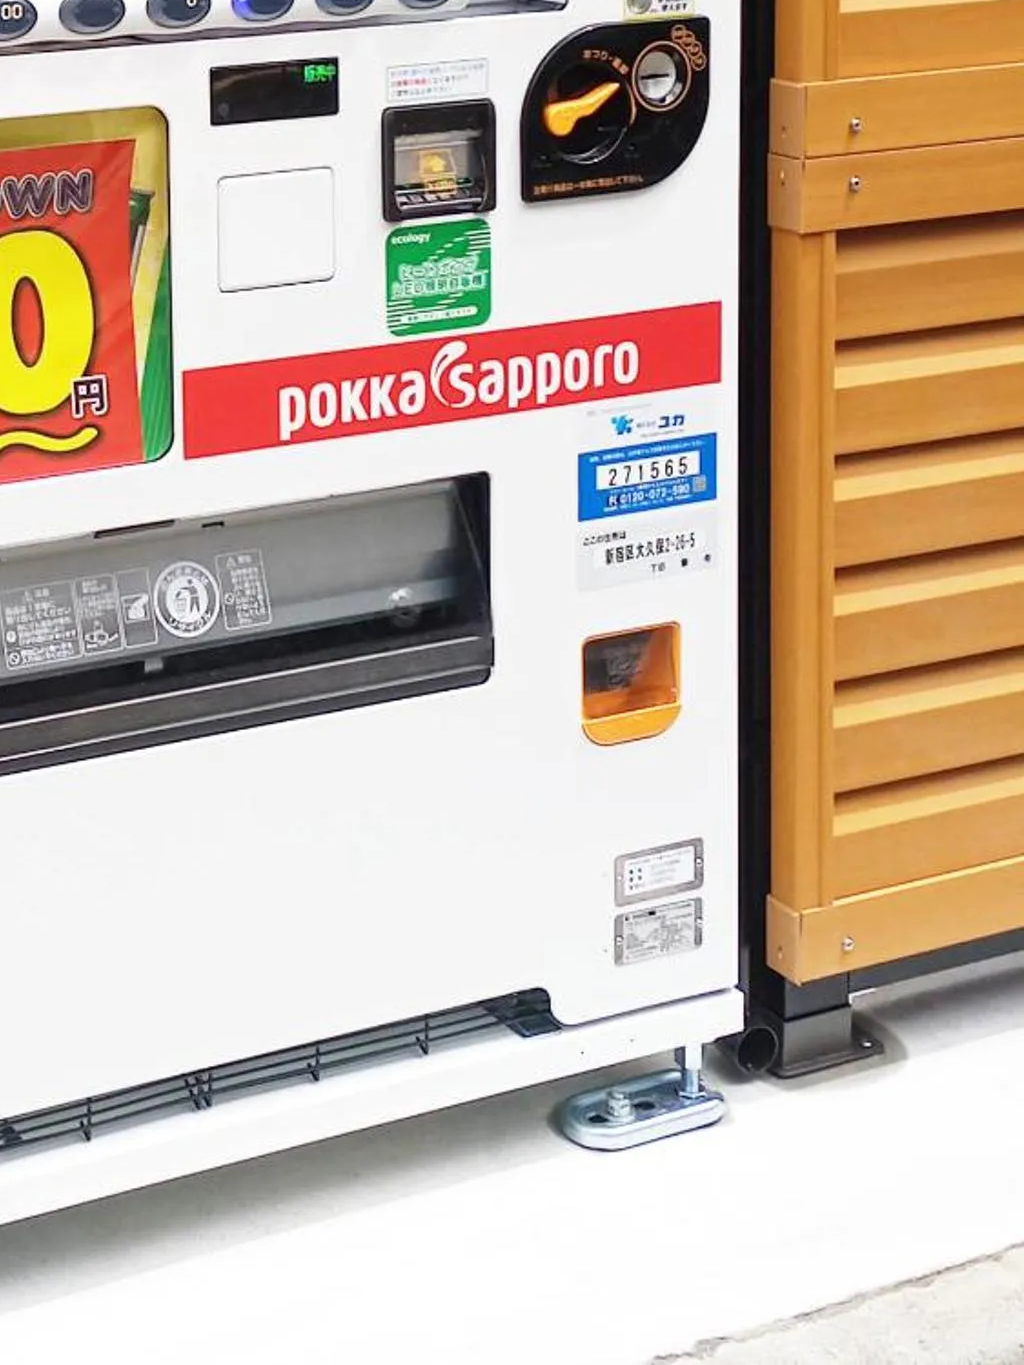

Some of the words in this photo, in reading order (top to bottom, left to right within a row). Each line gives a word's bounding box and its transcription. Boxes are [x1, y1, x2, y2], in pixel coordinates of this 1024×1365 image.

[391, 233, 432, 245] ecology
[278, 369, 426, 440] pokka
[430, 340, 640, 409] sapporo
[608, 456, 689, 486] 271565
